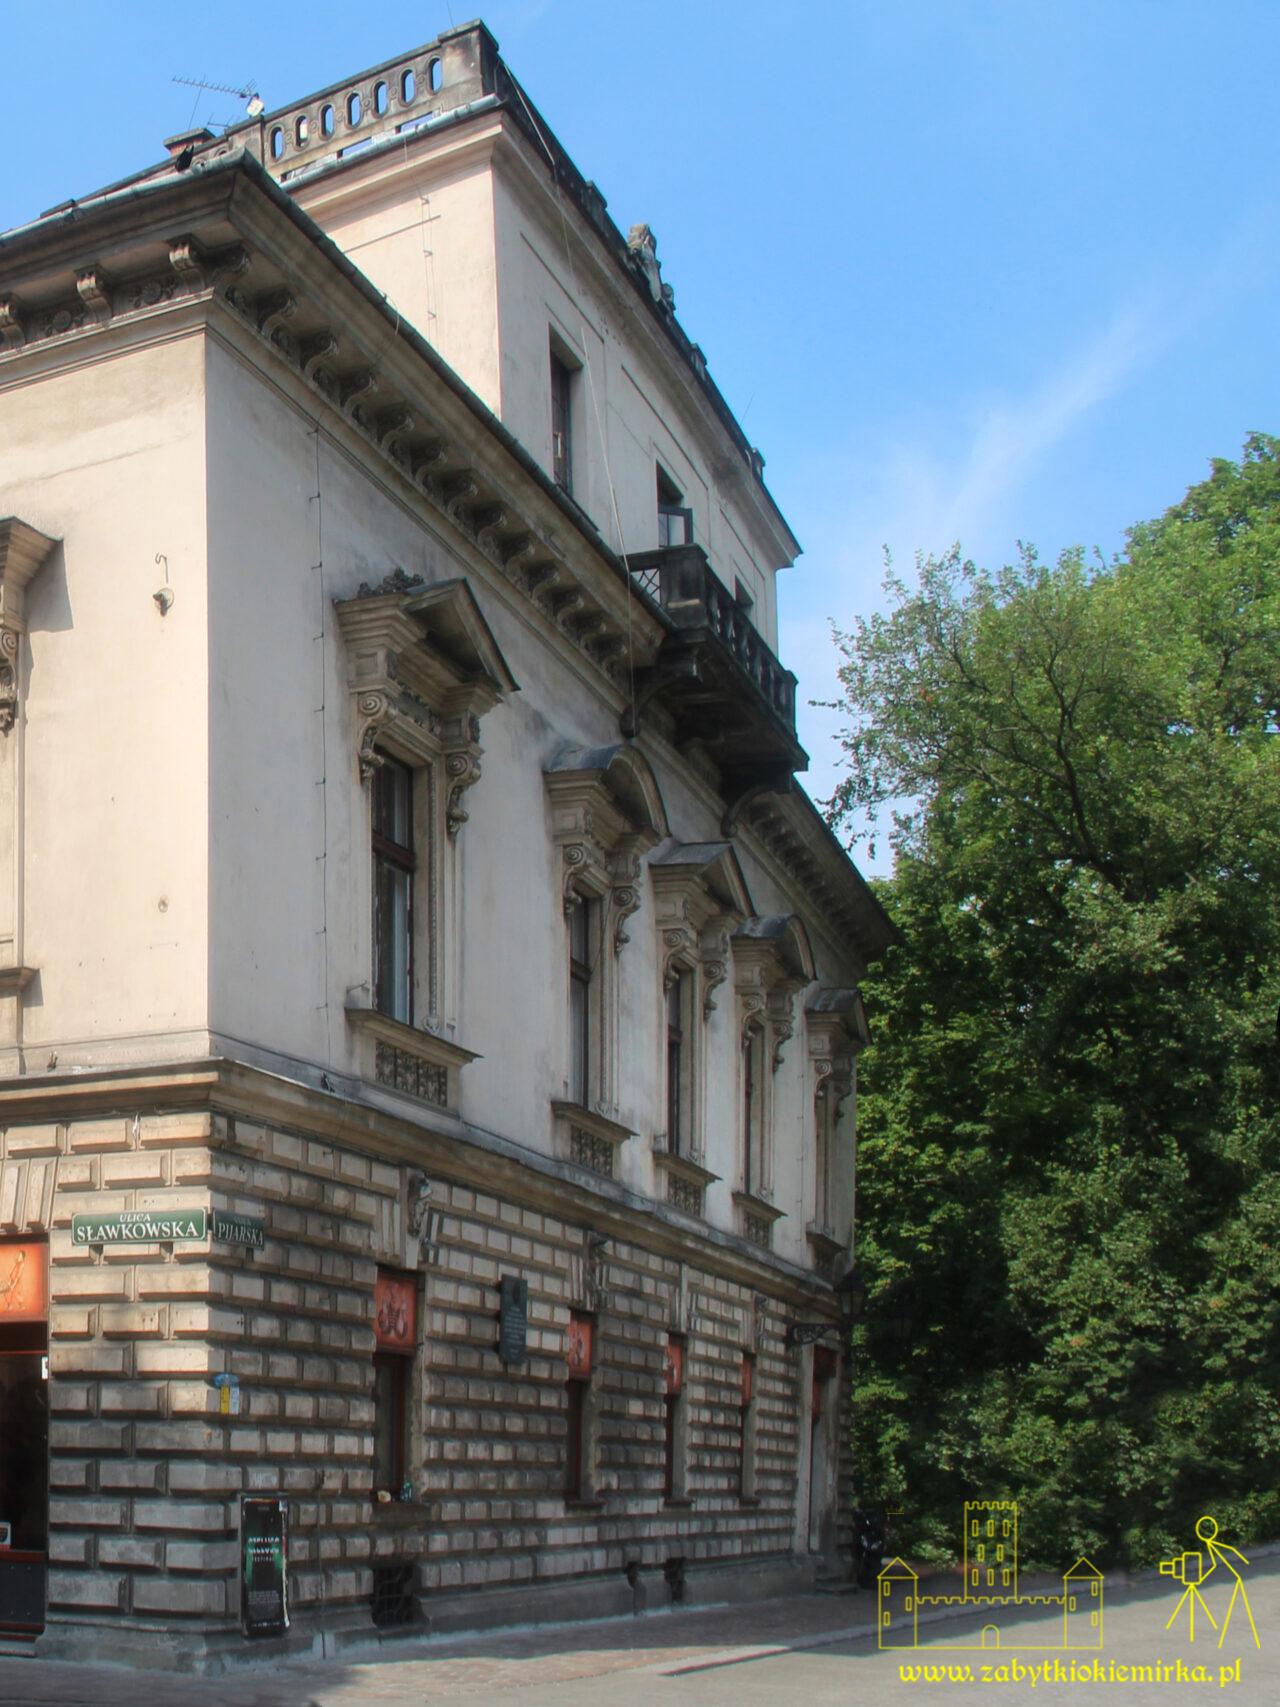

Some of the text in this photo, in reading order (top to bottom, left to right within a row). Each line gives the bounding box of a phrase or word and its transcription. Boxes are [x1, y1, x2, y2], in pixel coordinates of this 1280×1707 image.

[119, 1213, 151, 1223] ULICA
[76, 1221, 199, 1242] SŁAWKOWSKA
[218, 1223, 264, 1246] PIJARSKA
